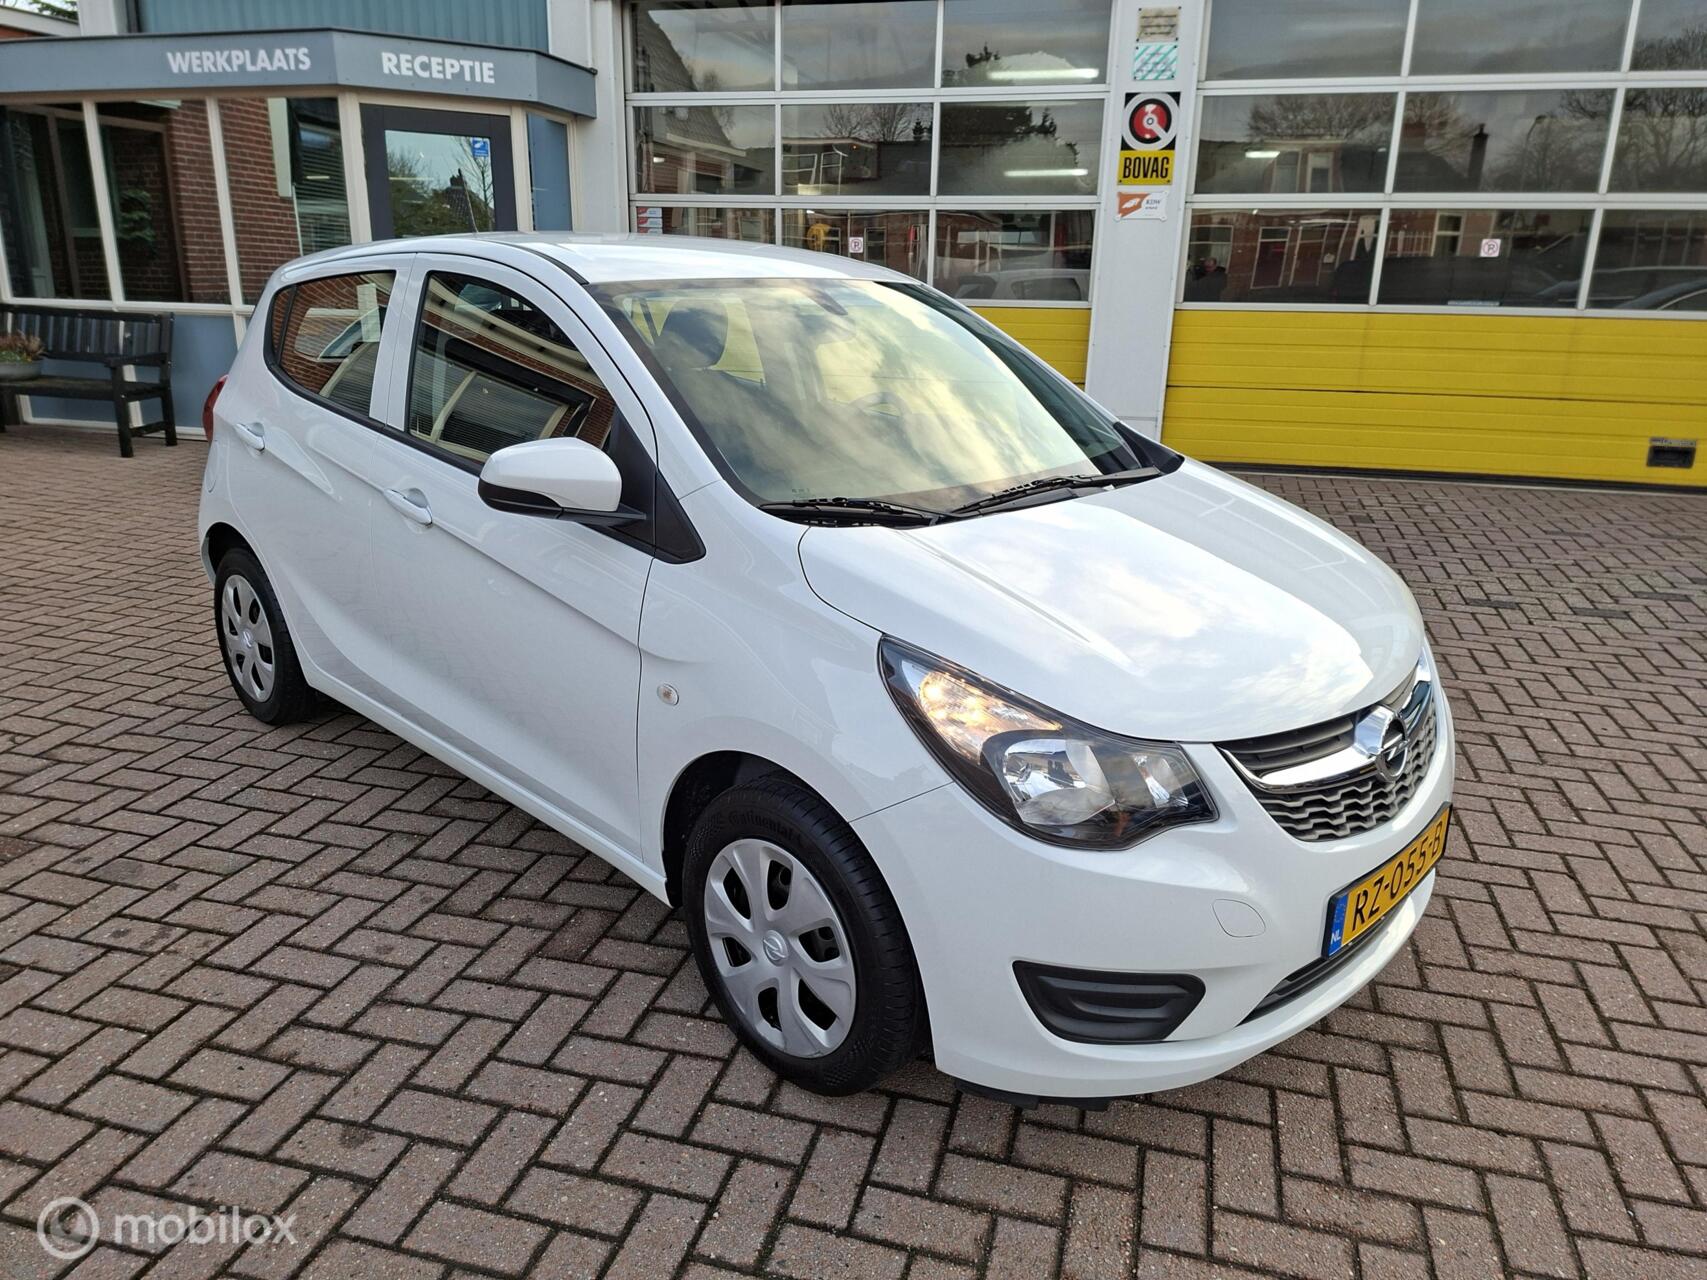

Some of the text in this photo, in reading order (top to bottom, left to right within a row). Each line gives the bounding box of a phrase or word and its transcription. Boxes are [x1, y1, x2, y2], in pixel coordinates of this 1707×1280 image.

[167, 48, 311, 73] WERKPLAATS
[381, 52, 495, 84] RECEPTIE
[1123, 156, 1169, 179] BOVAG
[1352, 820, 1443, 932] RZ-055-B
[1330, 931, 1342, 944] NL
